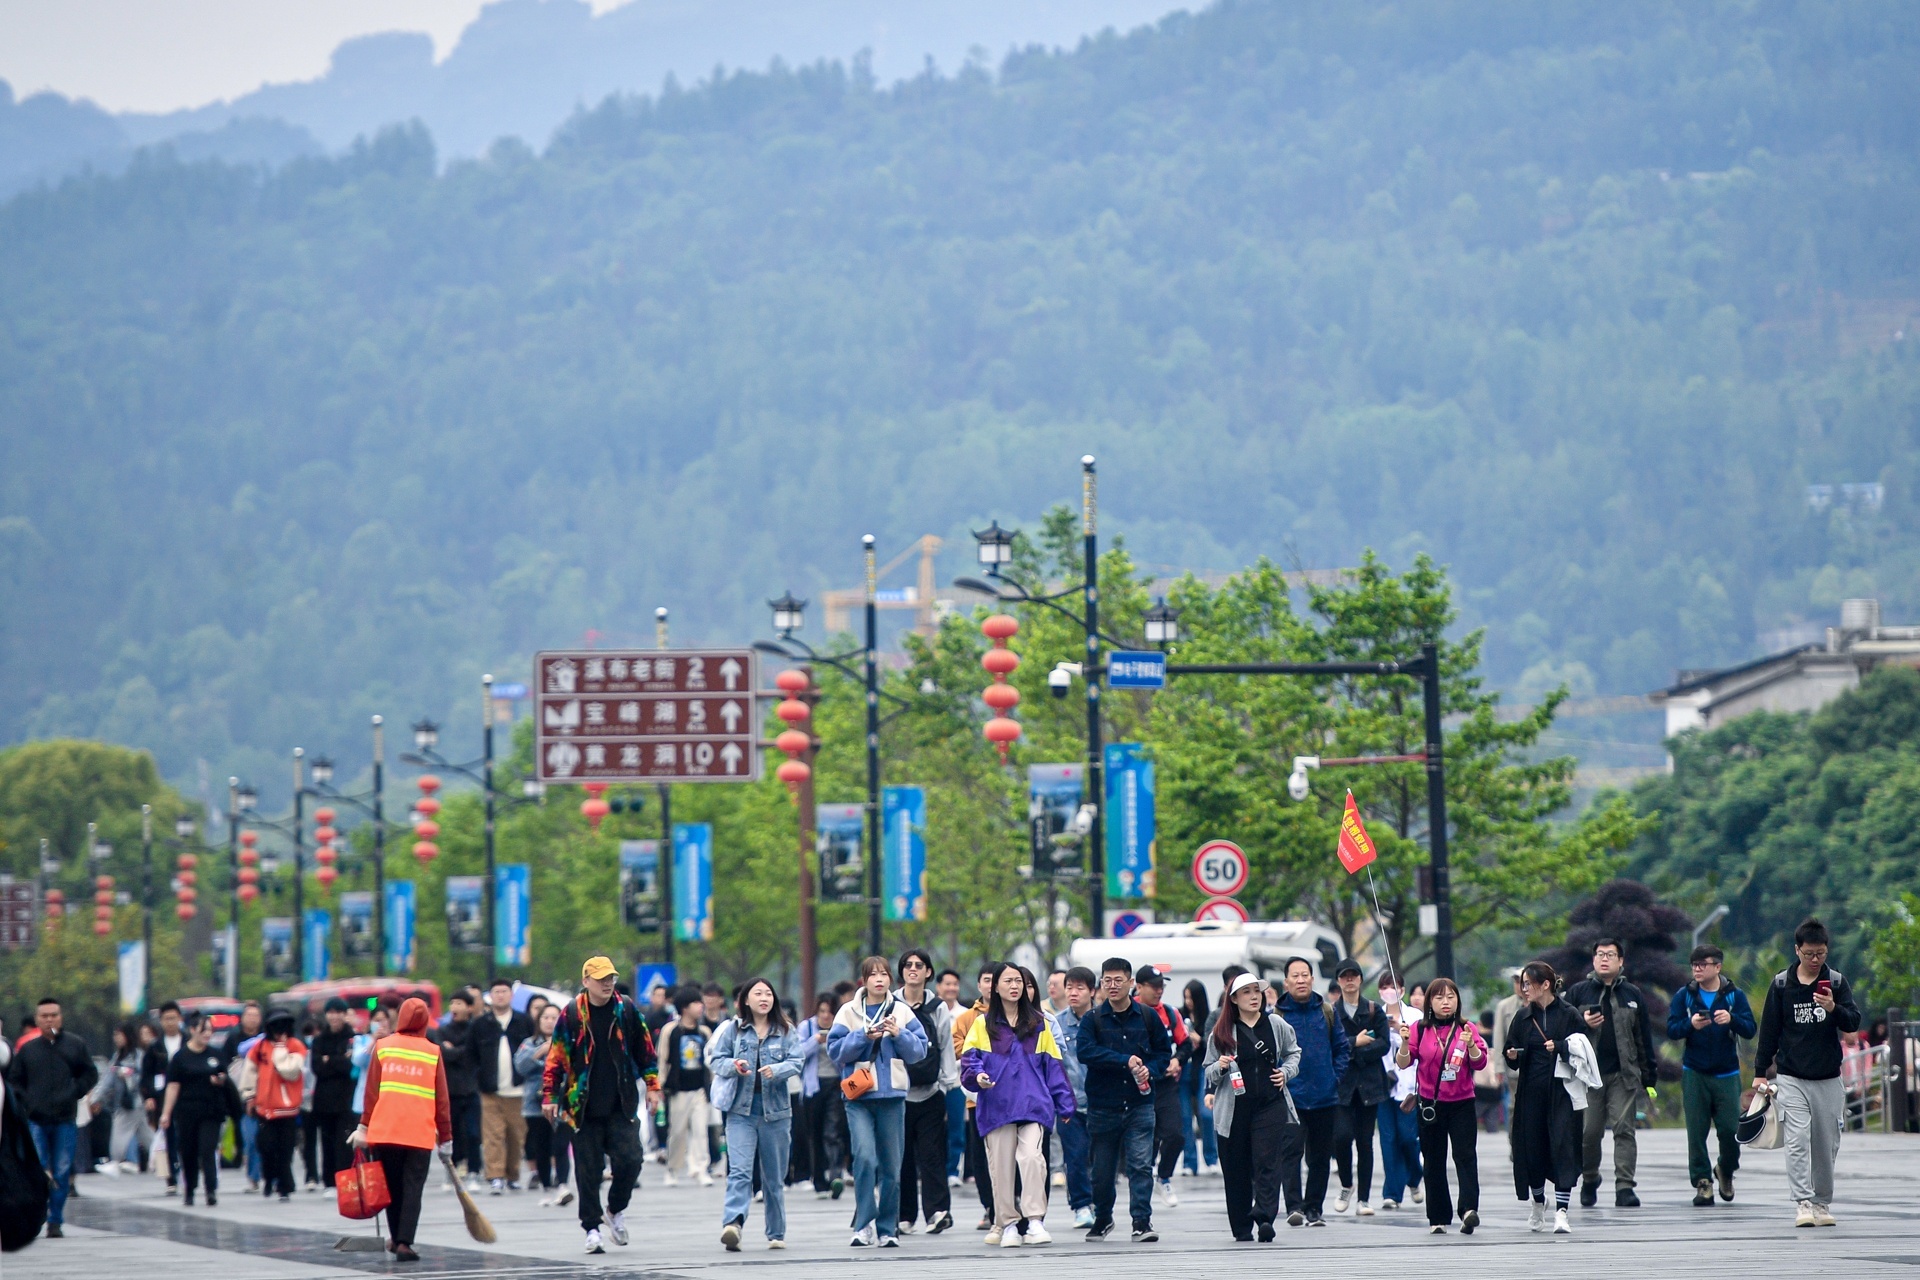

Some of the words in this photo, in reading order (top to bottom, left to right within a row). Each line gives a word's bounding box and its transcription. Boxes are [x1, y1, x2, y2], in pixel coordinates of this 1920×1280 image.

[688, 657, 705, 680] 2
[584, 700, 677, 725] 宝峰湖
[688, 699, 706, 722] 5
[584, 743, 677, 767] 黄龙洞
[683, 742, 714, 766] 10
[1205, 859, 1237, 880] 50
